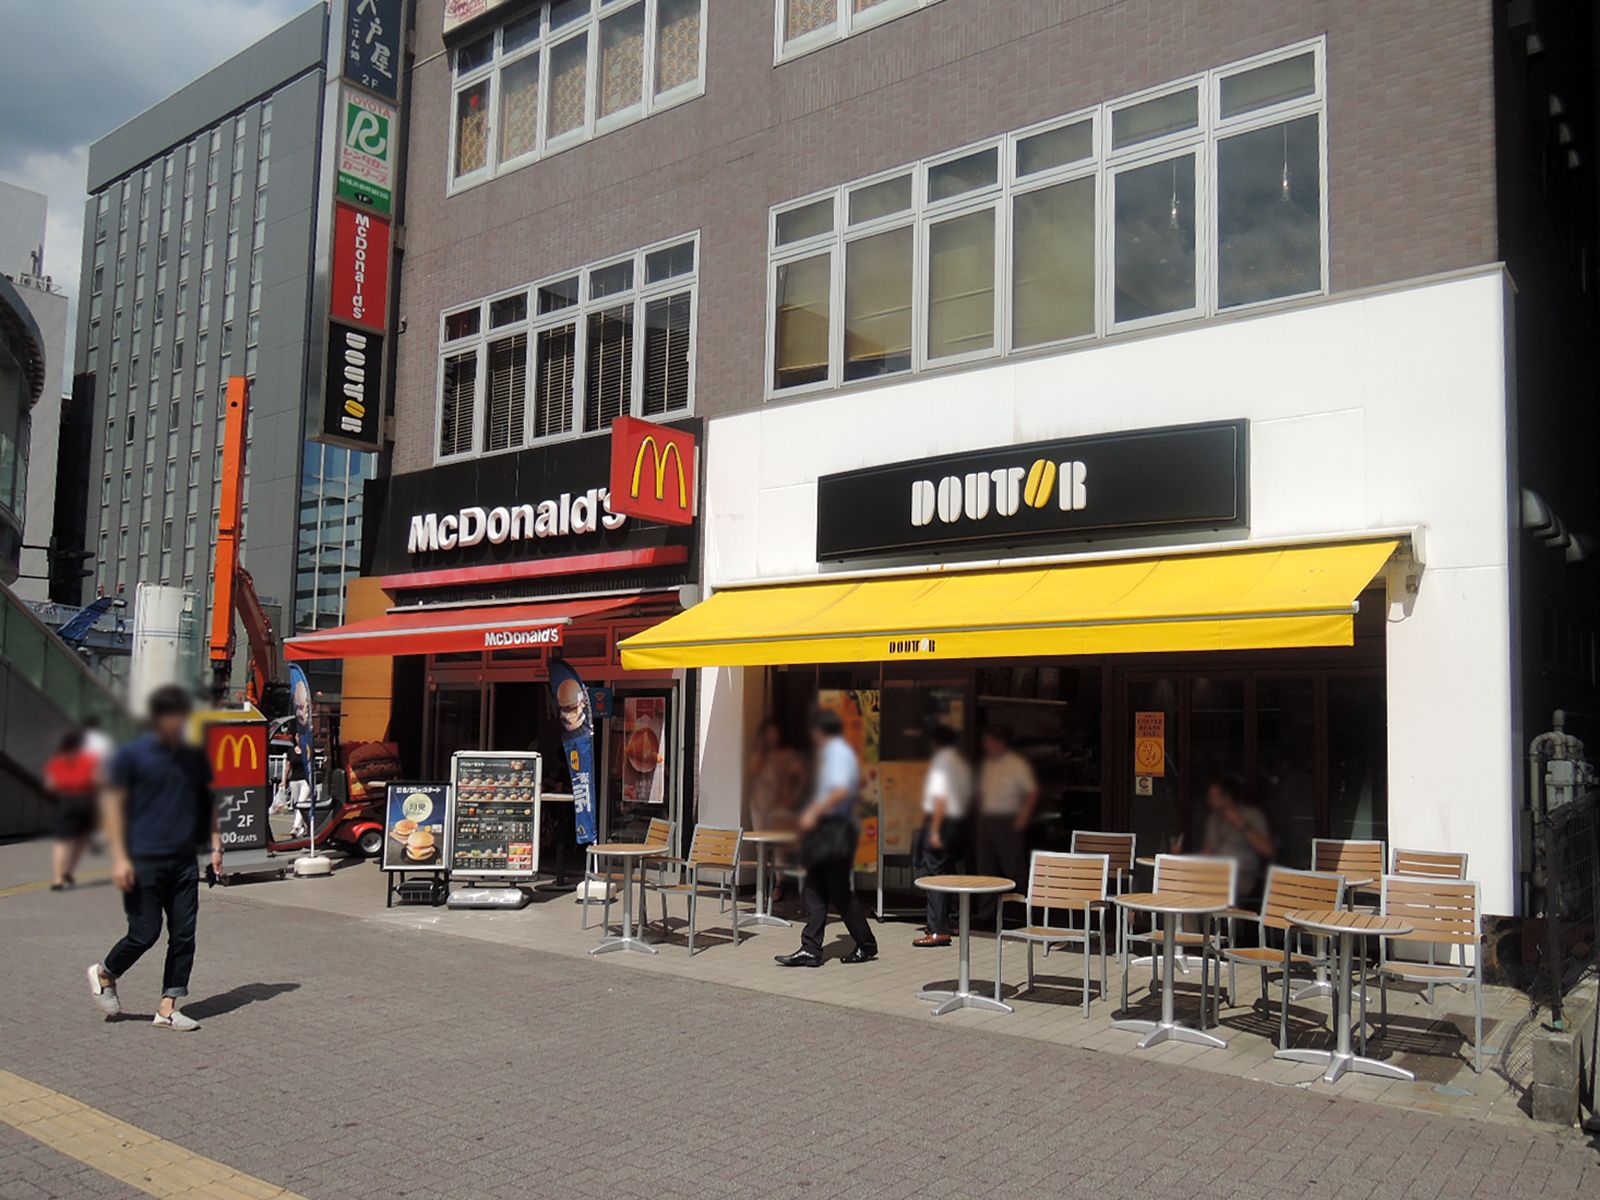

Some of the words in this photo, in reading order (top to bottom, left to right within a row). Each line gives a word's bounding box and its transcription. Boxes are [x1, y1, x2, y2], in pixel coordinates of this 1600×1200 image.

[362, 74, 378, 88] 2F
[347, 90, 392, 119] TOYOTA
[343, 148, 389, 171] レンタカー
[342, 161, 388, 186] カーリース
[352, 213, 370, 319] McDonald's
[341, 332, 367, 433] DOUTOR
[911, 459, 1087, 527] DOUTOR
[408, 487, 627, 554] McDonald's
[484, 627, 560, 647] McDonald's
[889, 637, 936, 654] DOUTOR
[237, 814, 254, 828] 2F
[221, 831, 237, 844] 00
[237, 834, 257, 843] SEATS
